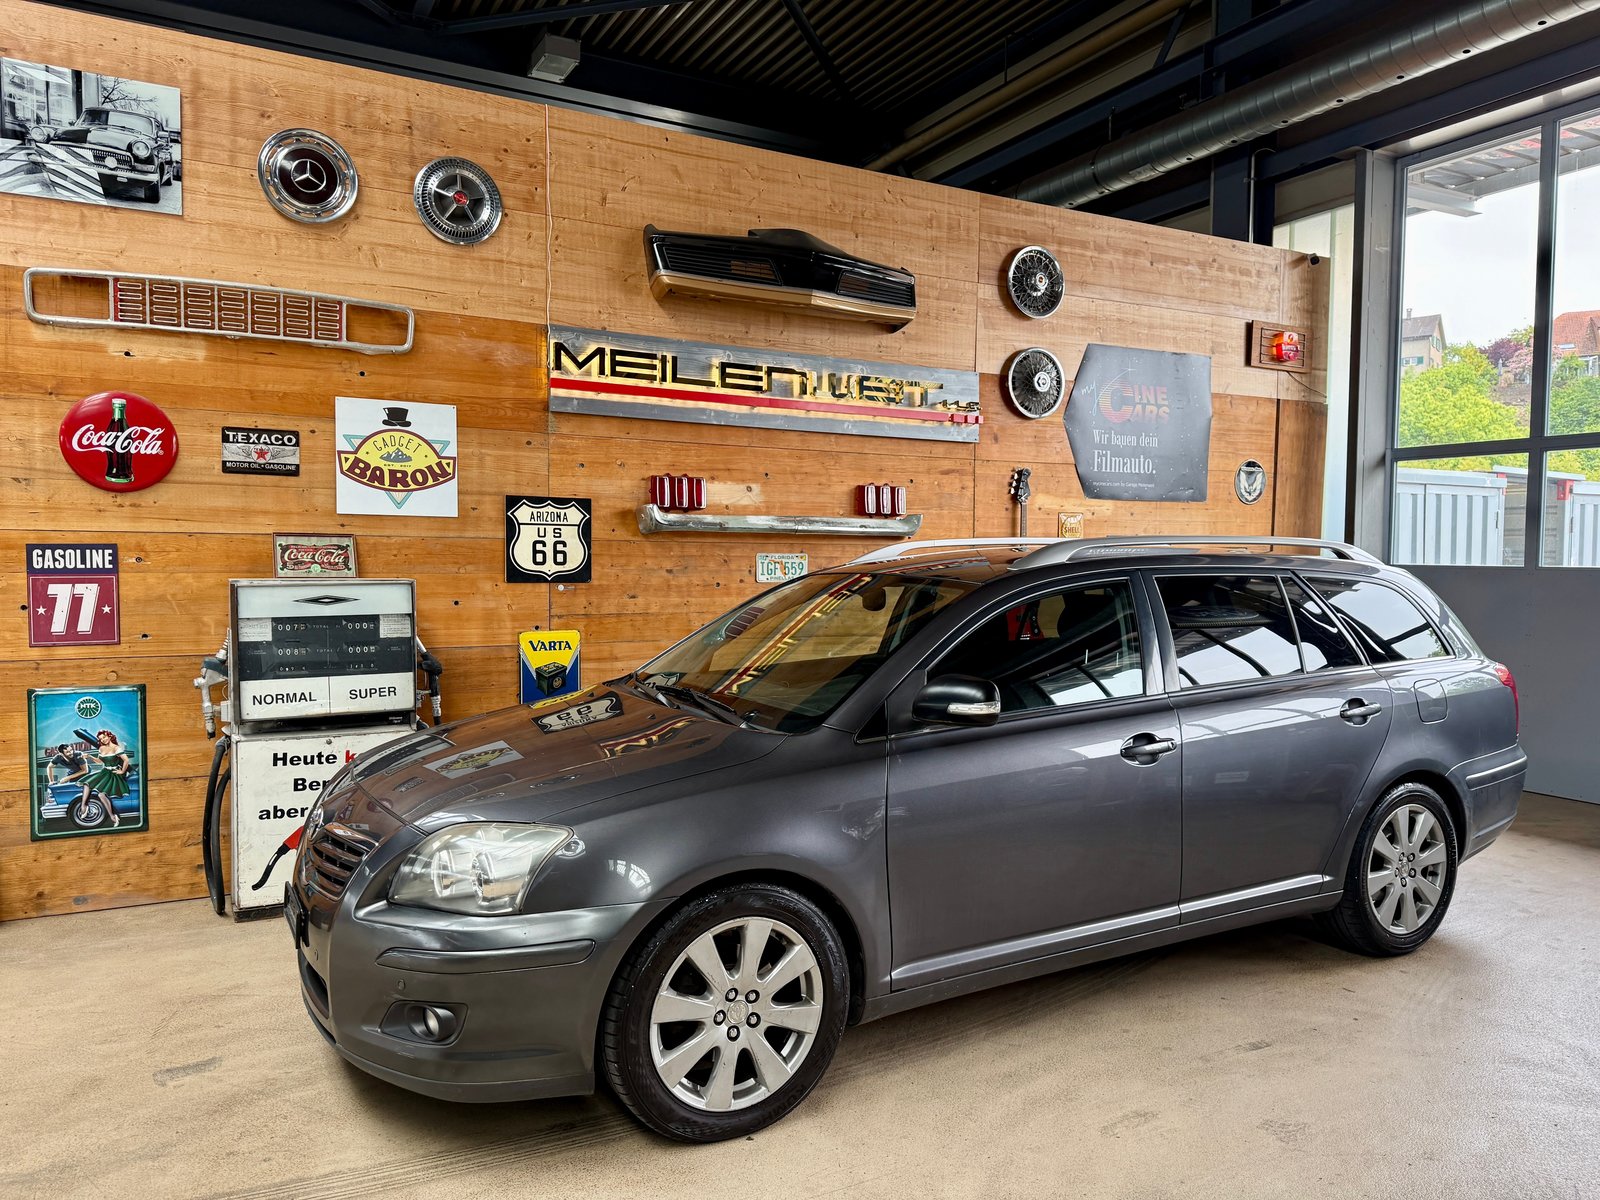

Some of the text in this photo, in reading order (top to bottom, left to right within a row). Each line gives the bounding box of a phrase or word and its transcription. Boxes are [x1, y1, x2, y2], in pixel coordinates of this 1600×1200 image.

[72, 424, 165, 455] Coca-Cola
[225, 430, 297, 445] TEXACO
[372, 434, 422, 453] GADGET
[1093, 430, 1158, 447] Wir bauen dein
[1093, 450, 1156, 474] Filmauto.
[345, 456, 452, 488] BARON
[530, 511, 568, 522] ARIZONA
[32, 549, 113, 569] GASOLINE
[284, 548, 347, 563] Coca-Cola
[532, 540, 567, 566] 66
[47, 584, 100, 635] 77
[528, 640, 572, 652] VARTA
[252, 691, 317, 706] NORMAL
[349, 686, 397, 700] SUPER
[272, 751, 338, 767] Heute
[258, 805, 308, 820] aber
